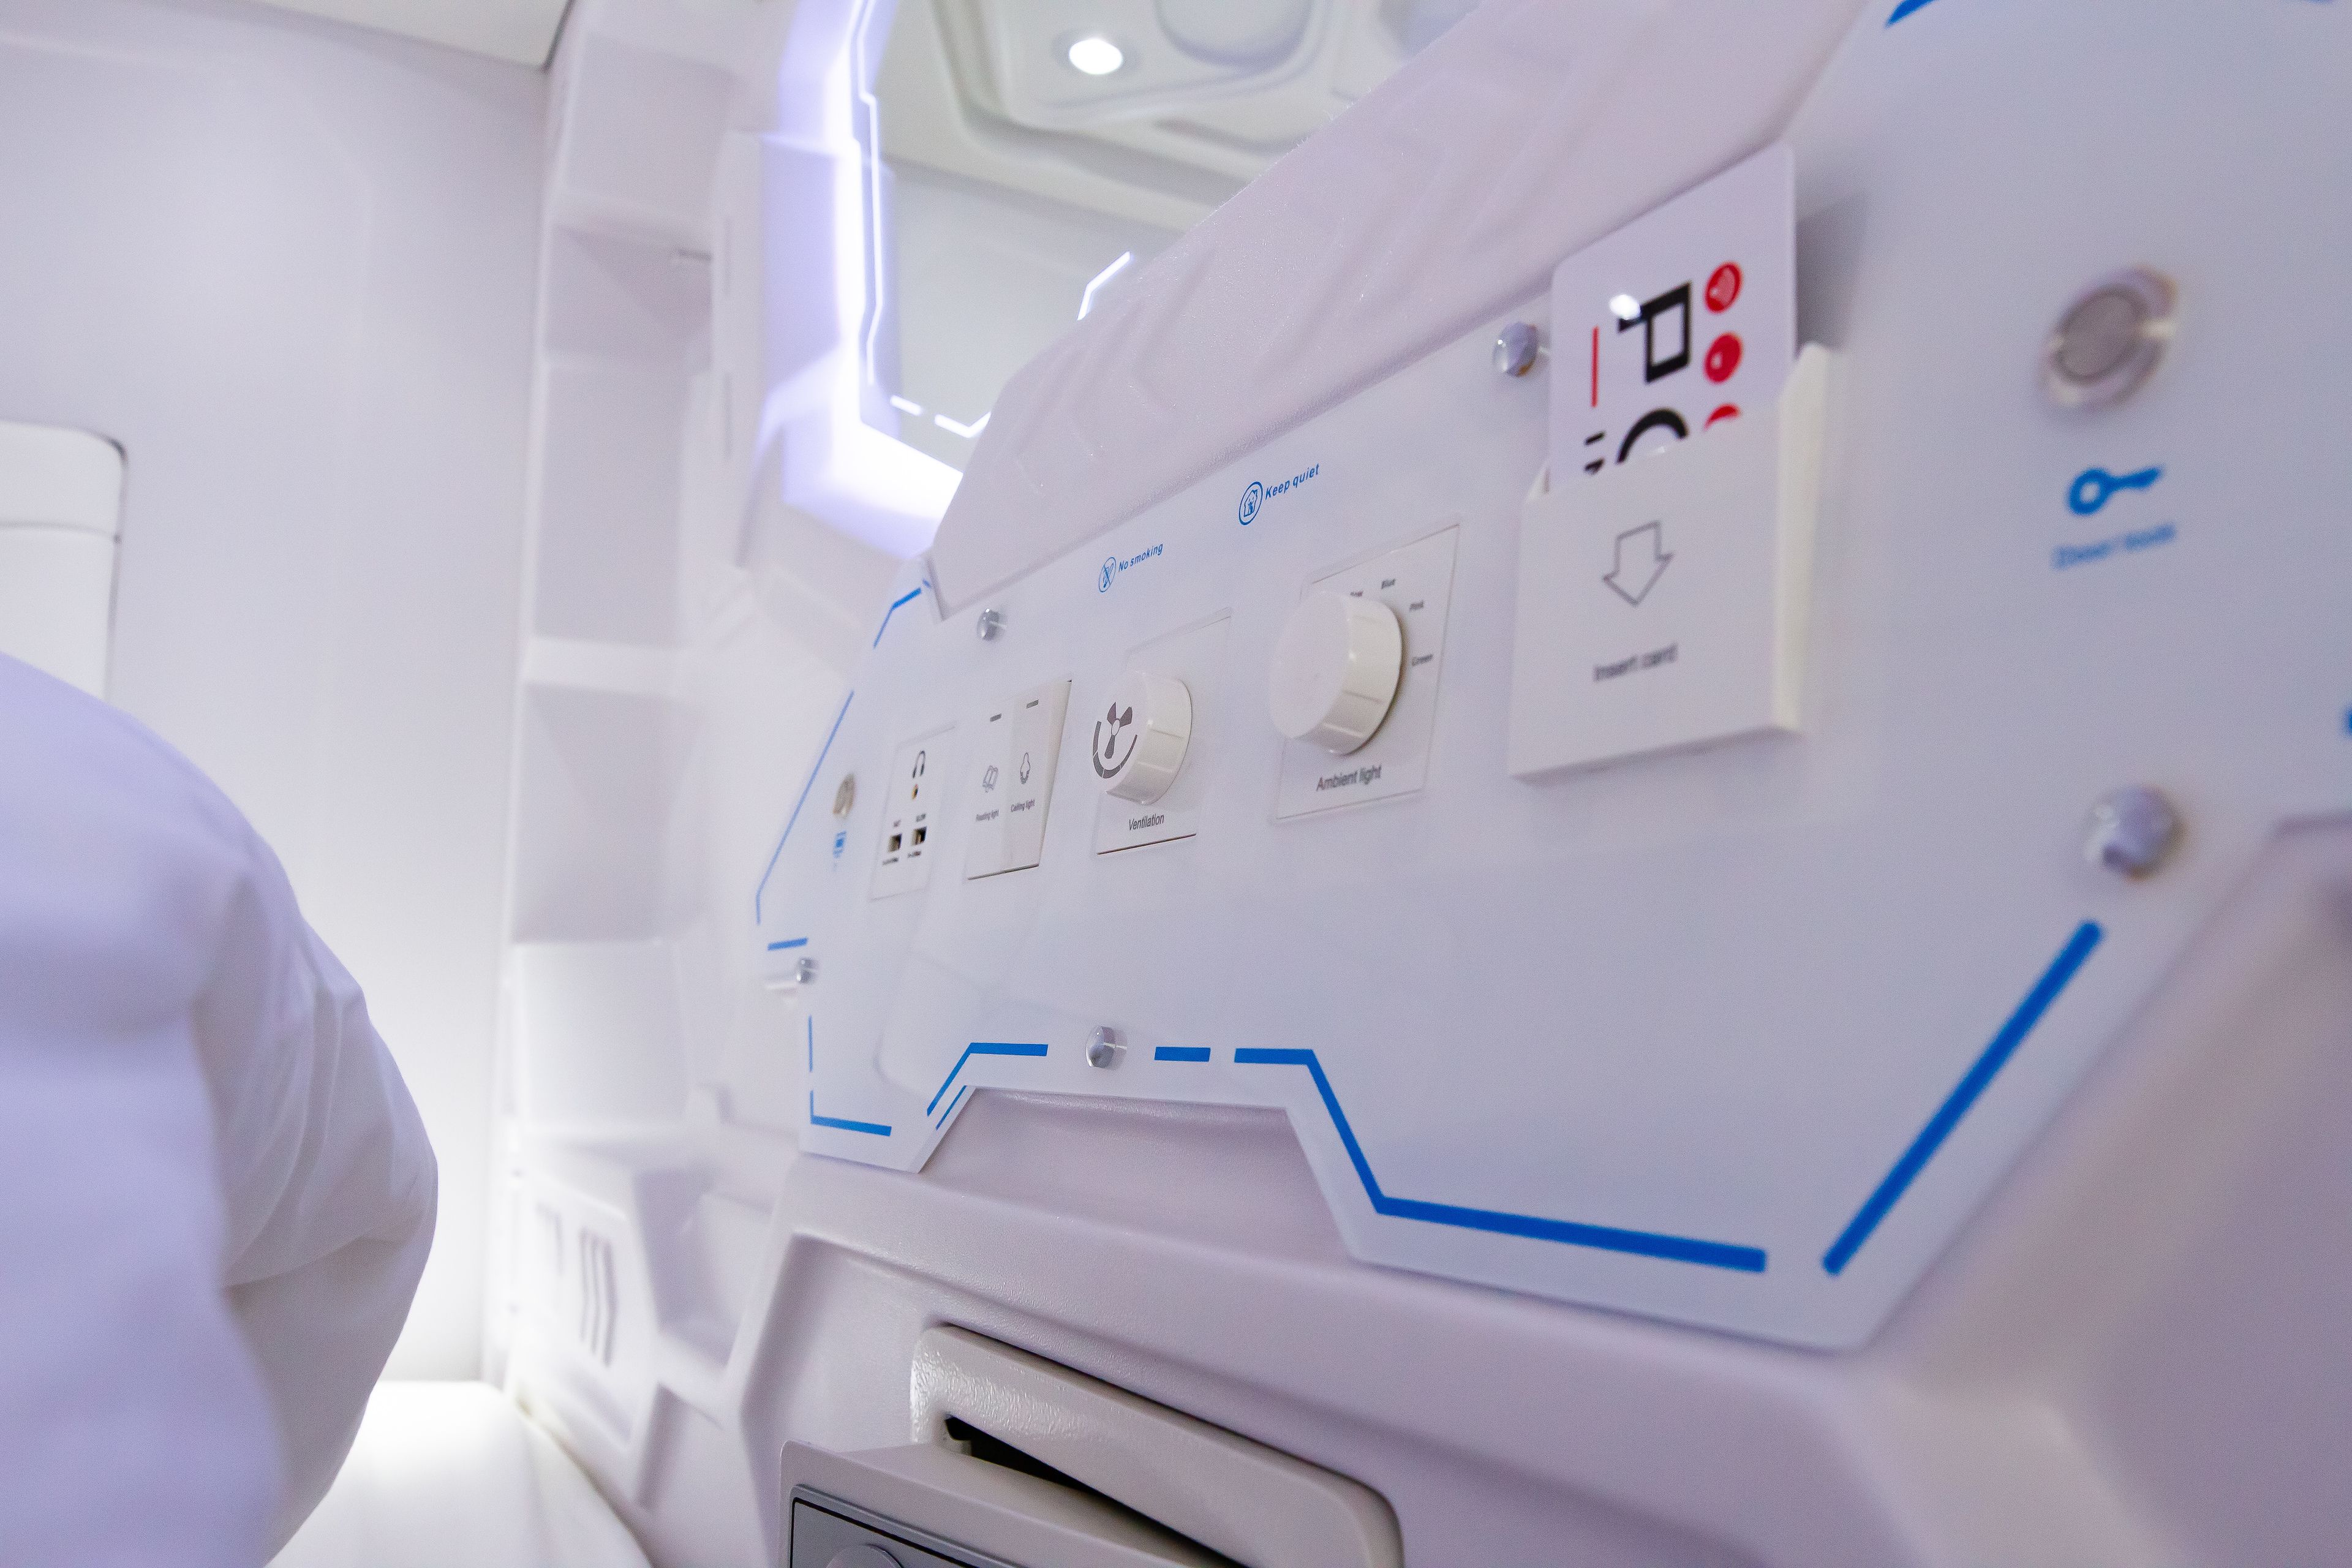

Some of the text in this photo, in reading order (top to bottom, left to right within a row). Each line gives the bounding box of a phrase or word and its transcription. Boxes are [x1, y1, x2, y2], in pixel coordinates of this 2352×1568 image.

[1265, 463, 1320, 501] Keep quiet
[1118, 543, 1163, 572] No smoking
[1316, 763, 1382, 791] Ambient light
[1129, 813, 1164, 831] Ventilation
